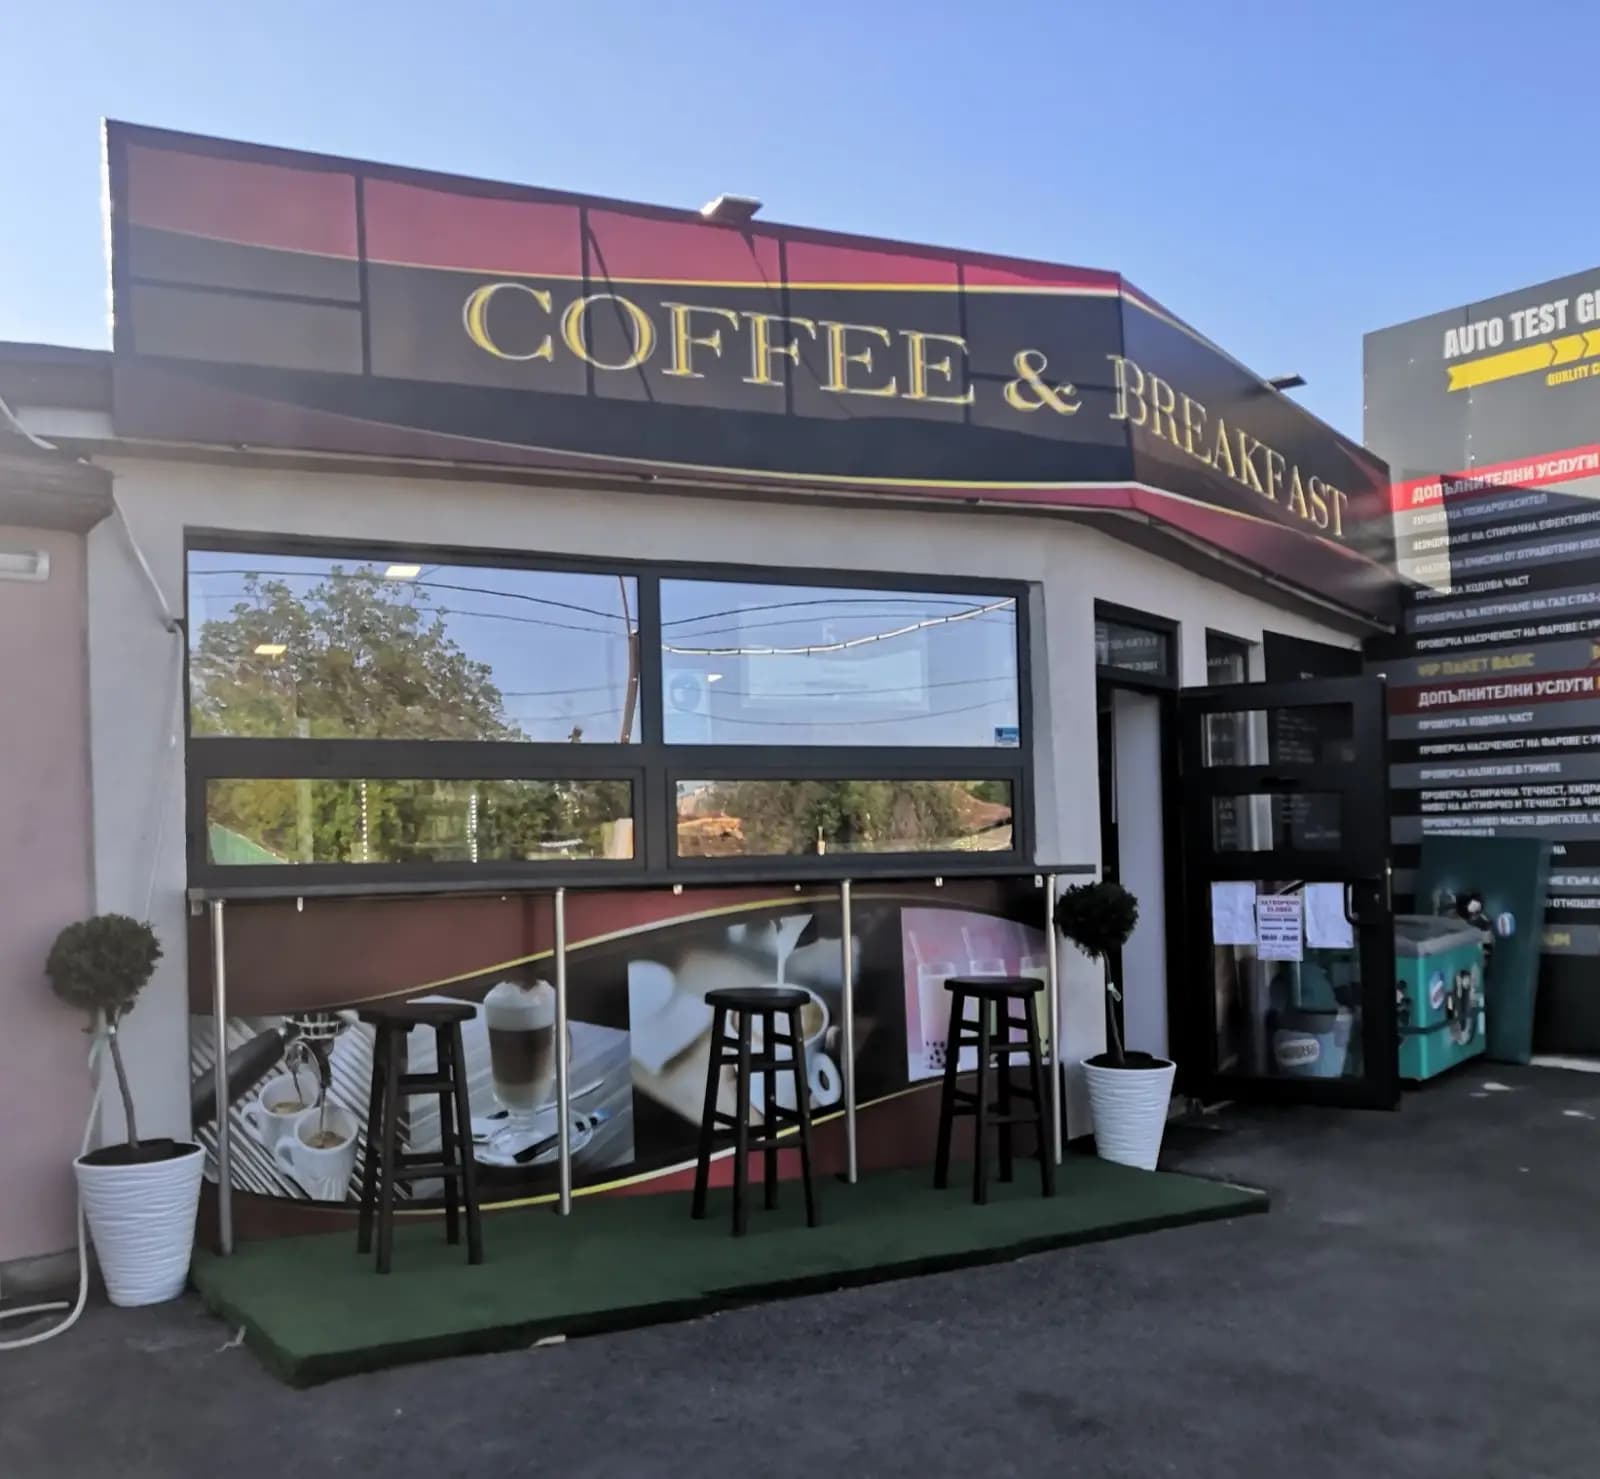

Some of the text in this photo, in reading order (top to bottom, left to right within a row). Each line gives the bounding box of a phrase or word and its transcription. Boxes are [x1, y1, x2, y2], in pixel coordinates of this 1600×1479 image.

[1443, 317, 1505, 359] AUTO
[1509, 298, 1570, 341] TEST
[1546, 363, 1590, 387] QUALITY
[462, 282, 1348, 537] COFFEE & BREAKFAST
[1412, 453, 1600, 504] ДОПЪЛНИТЕЛНИ УСЛУГИ
[1504, 574, 1530, 587] ЧАСТ
[1418, 676, 1595, 708] ДОПЪЛНИТЕЛНИ УСЛУГИ
[1523, 797, 1567, 809] ТЕЧНОСТ
